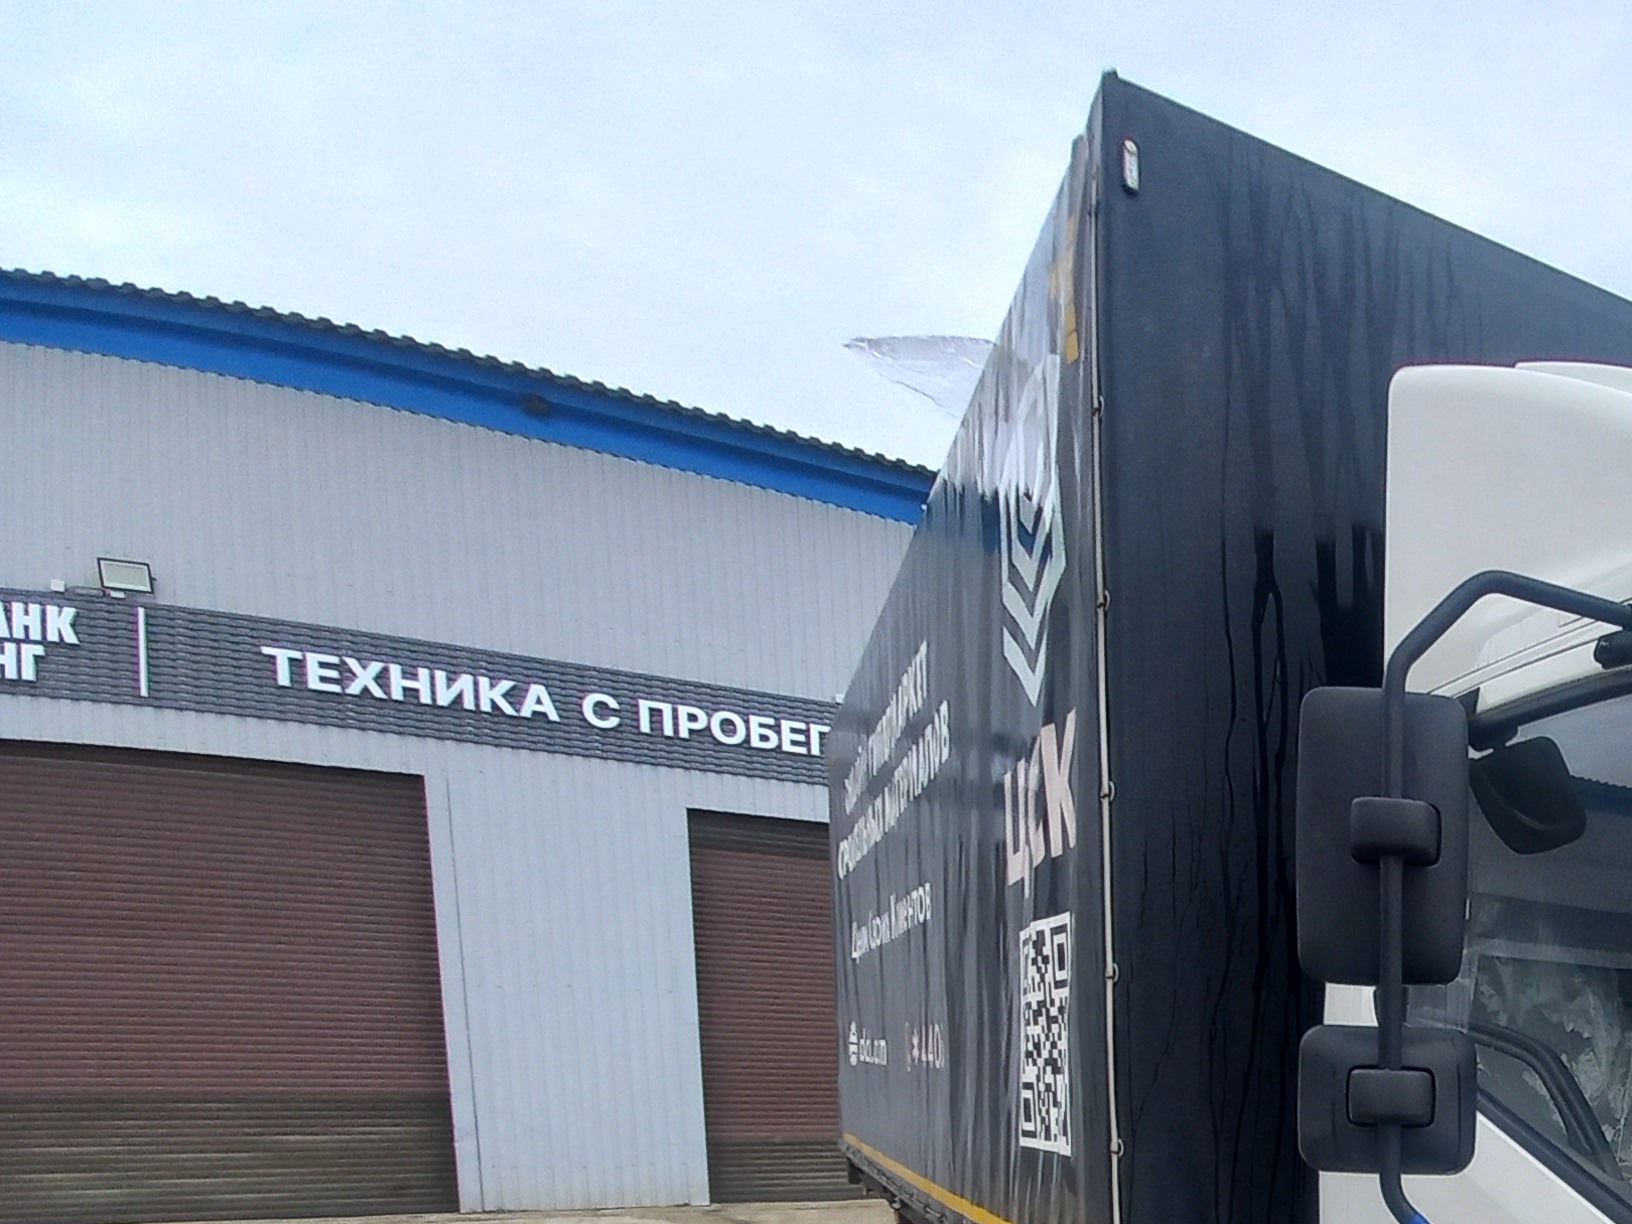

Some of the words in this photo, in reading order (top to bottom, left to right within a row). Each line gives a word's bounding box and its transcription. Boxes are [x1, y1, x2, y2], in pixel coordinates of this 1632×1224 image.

[260, 645, 561, 722] ТЕХНИКА
[581, 693, 621, 729] С
[637, 699, 831, 757] ПРОБЕГ
[1003, 707, 1077, 899] ЦСК
